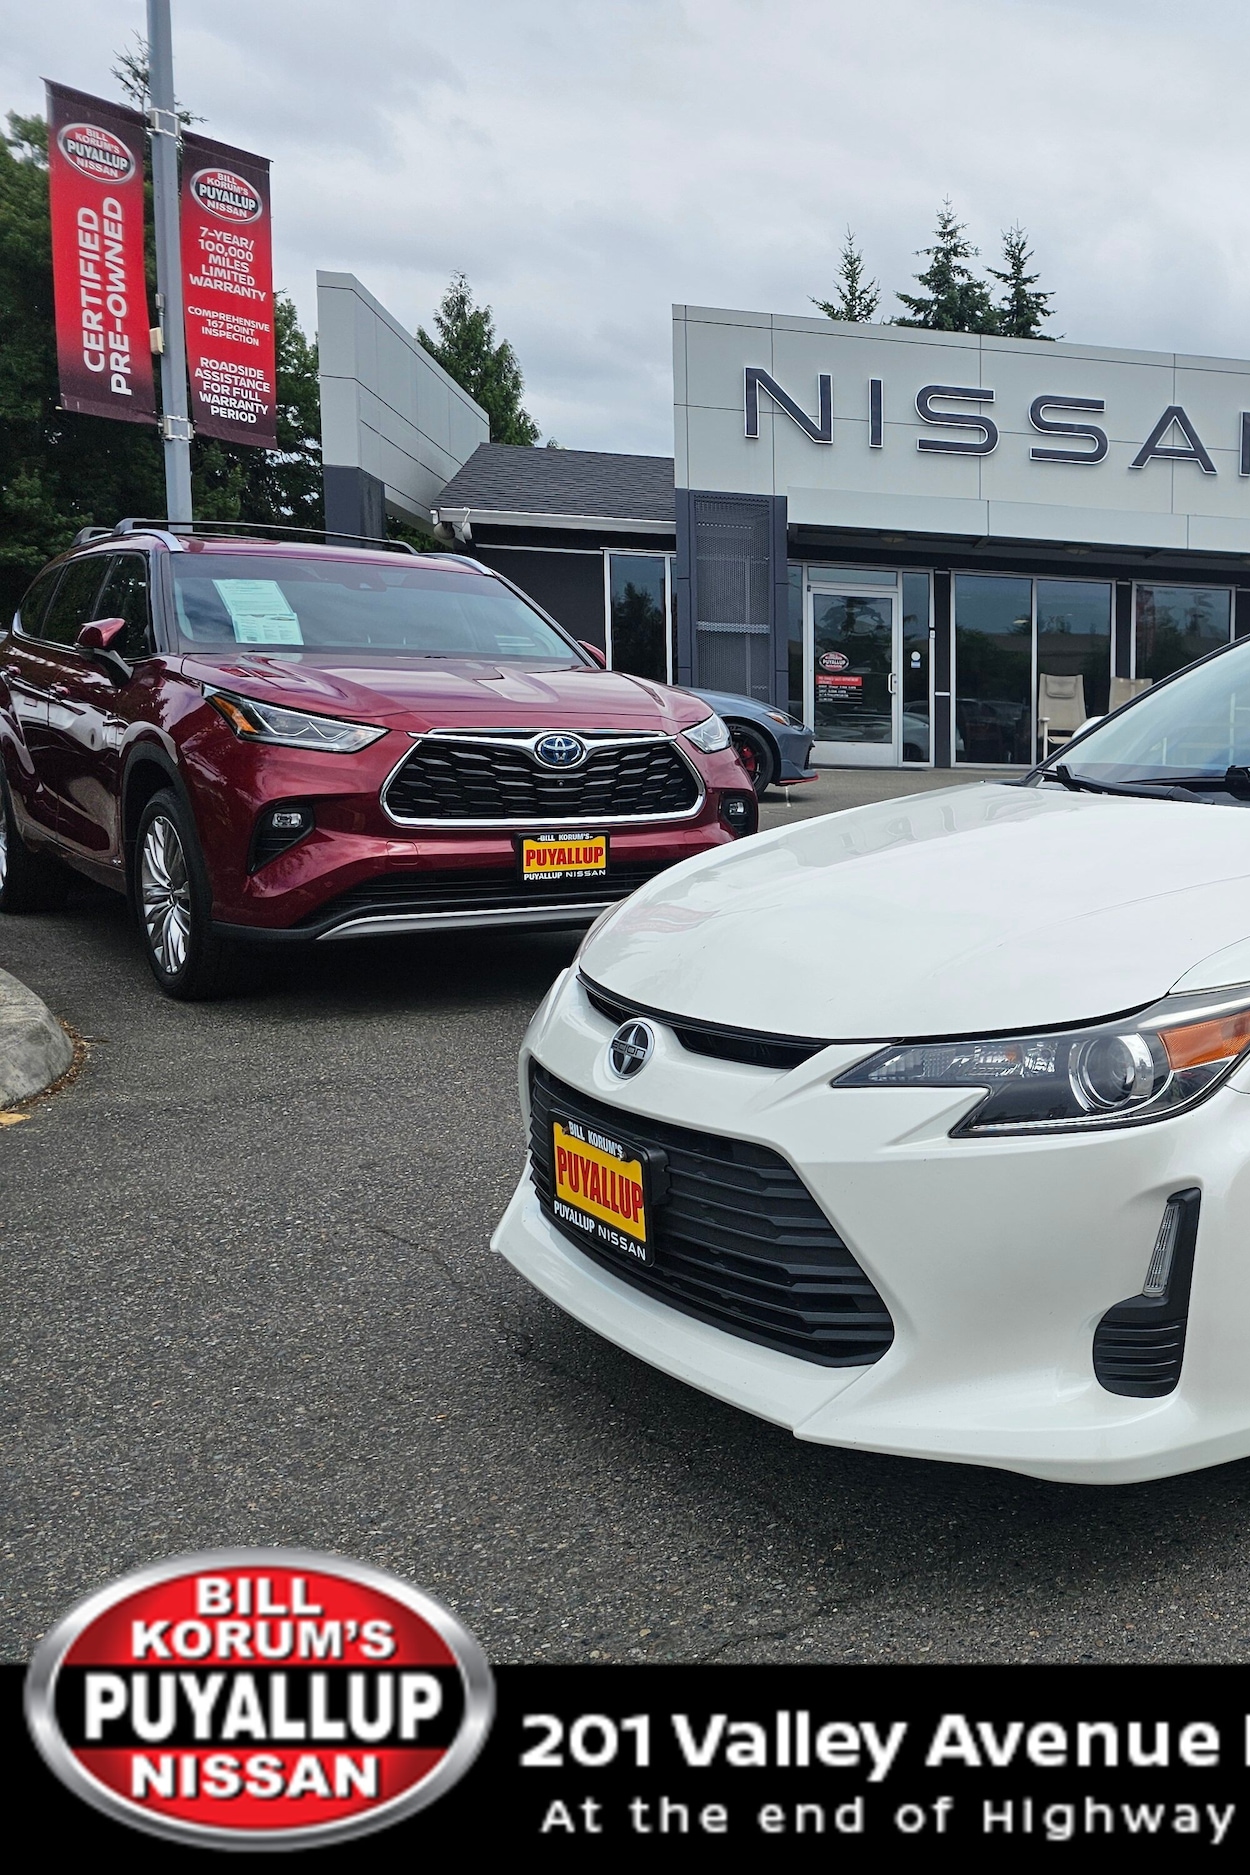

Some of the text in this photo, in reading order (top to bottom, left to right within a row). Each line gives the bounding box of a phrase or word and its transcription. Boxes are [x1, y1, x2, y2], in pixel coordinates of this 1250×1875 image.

[75, 132, 120, 154] KORUM'S
[86, 128, 108, 142] BILL
[67, 139, 128, 170] PUYALLUP
[77, 157, 119, 178] NISSAN
[217, 172, 237, 185] BILL
[200, 184, 256, 211] PUYALLUP
[207, 177, 249, 196] KORUM'S
[207, 200, 248, 218] NISSAN
[200, 226, 255, 251] 7-YEAR/
[198, 239, 253, 262] 100,000
[208, 254, 250, 273] MILES
[202, 264, 255, 287] LIMITED
[77, 207, 105, 372] CERTIFIED
[103, 197, 133, 396] PRE-OWNED
[189, 273, 266, 302] WARRANTY
[188, 306, 270, 332] COMPREHENSIVE
[206, 319, 255, 337] 167 POINT
[201, 326, 259, 346] INSPECTION
[200, 357, 264, 380] ROADSIDE
[195, 368, 270, 393] ASSISTANCE
[203, 381, 262, 402] FOR FULL
[199, 391, 268, 415] WARRANTY
[211, 405, 257, 424] PERIOD
[525, 847, 604, 867] PUYALLUP
[524, 869, 606, 881] PUYALLUP NISSAN
[568, 1120, 586, 1141] BILL
[556, 1145, 644, 1224] PUYALLUP
[554, 1200, 646, 1261] PUYALLUP NISSAN
